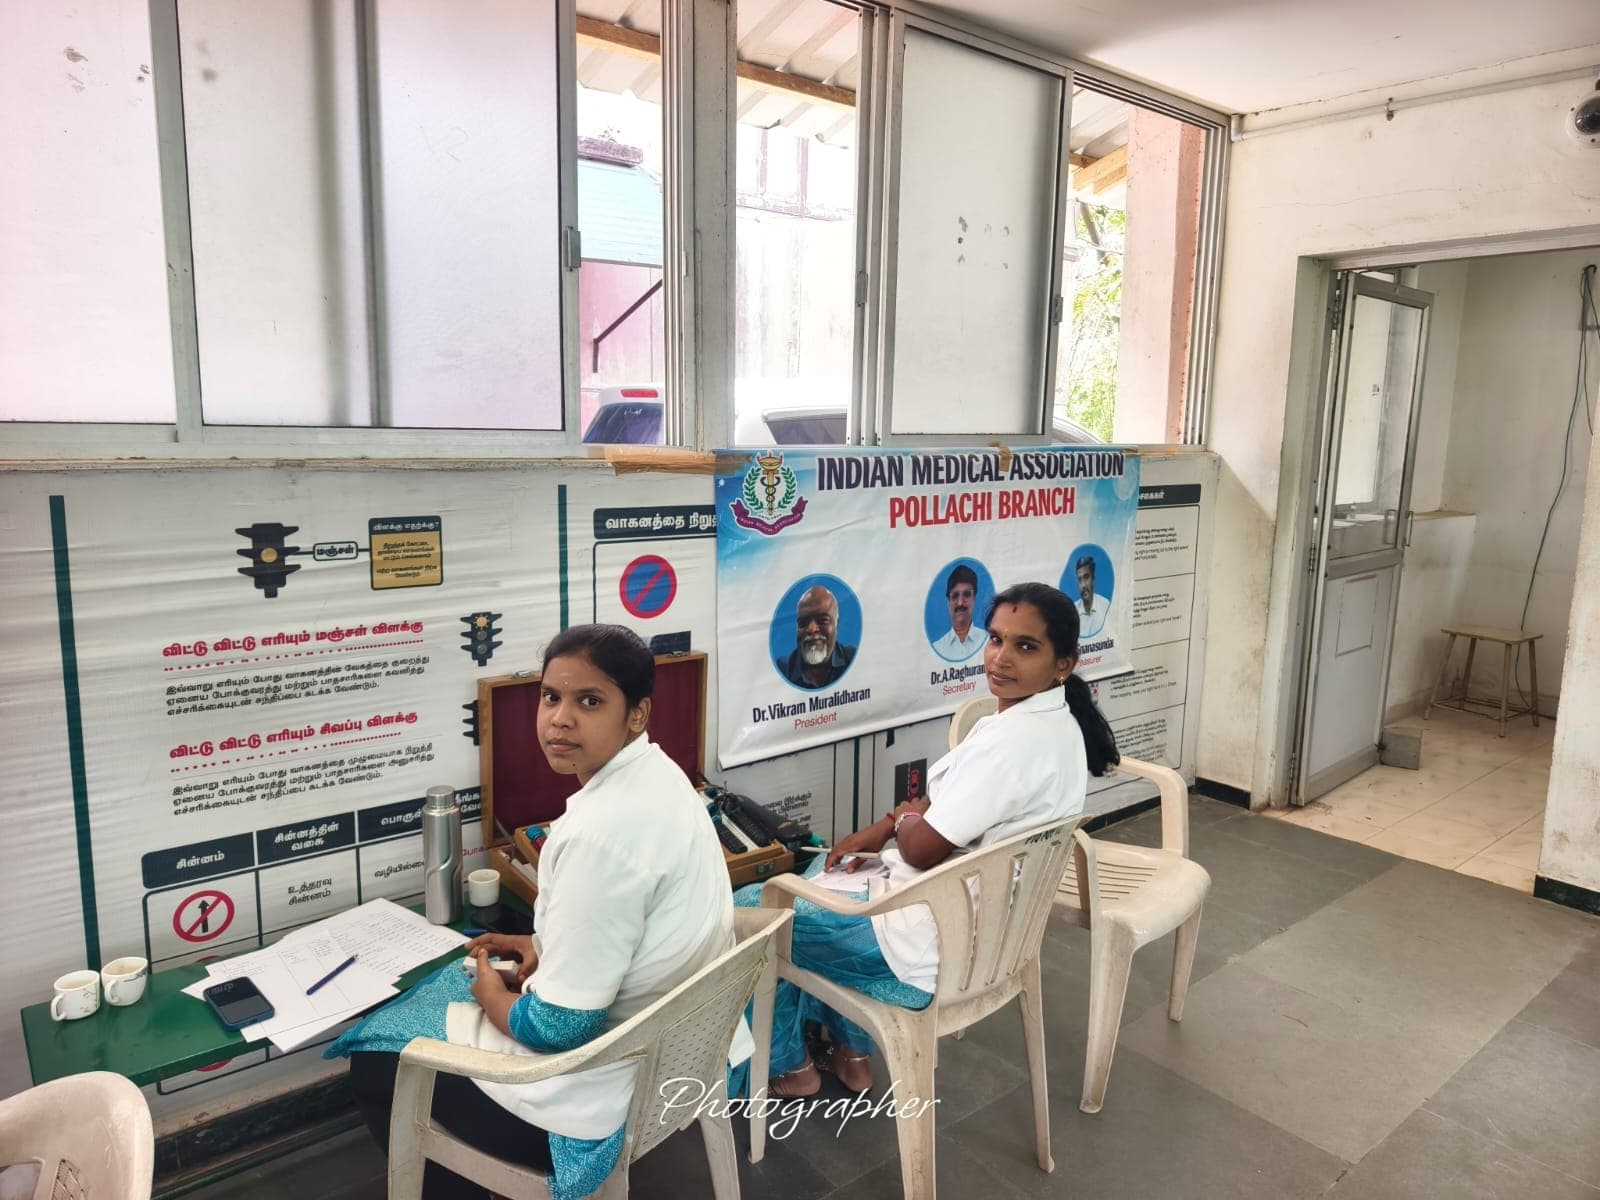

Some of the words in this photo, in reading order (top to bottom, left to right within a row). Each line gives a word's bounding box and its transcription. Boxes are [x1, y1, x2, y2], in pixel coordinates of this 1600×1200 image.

[817, 455, 904, 491] INDIAN
[911, 452, 1004, 486] MEDICAL
[1009, 450, 1124, 481] ASSOCIATION
[605, 513, 685, 531] வாகனத்தை
[889, 491, 992, 529] POLLACHI
[998, 487, 1076, 520] BRANCH
[316, 544, 354, 557] மஞ்சள்
[162, 642, 208, 657] விட்டு
[213, 637, 256, 651] விட்டு
[261, 629, 311, 645] எரியும்
[315, 624, 368, 641] மஞ்சள்
[371, 620, 424, 633] விளக்கு
[165, 683, 213, 696] இவ்வாறு
[216, 677, 250, 688] எரியும்
[252, 673, 282, 683] போது
[285, 665, 342, 680] வாகனத்தின்
[344, 660, 389, 672] வேகத்தை
[1079, 655, 1103, 667] asurer
[166, 694, 209, 706] ஏனைய
[211, 683, 281, 700] போக்குவரத்து
[284, 678, 318, 691] மற்றும்
[320, 671, 382, 686] பாதசாரிகளை
[384, 665, 425, 677] கவனித்து
[167, 698, 251, 716] எச்சரிக்கையுடன்
[255, 692, 302, 706] சந்திப்பை
[304, 687, 332, 698] கடக்க
[334, 681, 380, 693] வேண்டும்.
[943, 680, 976, 696] Secretary
[752, 700, 806, 723] Dr.Vikram
[808, 687, 871, 711] Muralidharan
[794, 712, 837, 730] President
[169, 741, 214, 759] விட்டு
[219, 734, 262, 750] விட்டு
[266, 725, 316, 743] எரியும்
[320, 719, 363, 735] சிவப்பு
[367, 712, 418, 728] விளக்கு
[173, 783, 219, 797] இவ்வாறு
[222, 774, 255, 786] எரியும்
[258, 768, 287, 778] போது
[290, 758, 346, 774] வாகனத்தை
[348, 749, 403, 764] முழுமையாக
[173, 793, 215, 807] ஏனைய
[218, 780, 287, 798] போக்குவரத்து
[289, 771, 322, 785] மற்றும்
[325, 762, 385, 777] பாதசாரிகளை
[174, 795, 257, 816] எச்சரிக்கையுடன்
[260, 786, 307, 801] சந்திப்பை
[309, 780, 336, 791] கடக்க
[338, 771, 384, 786] வேண்டும்.
[274, 821, 339, 843] சின்னத்தின்
[291, 836, 324, 851] வகை
[176, 851, 225, 869] சின்னம்
[288, 878, 332, 895] உத்தரவு
[288, 888, 332, 906] சின்னம்
